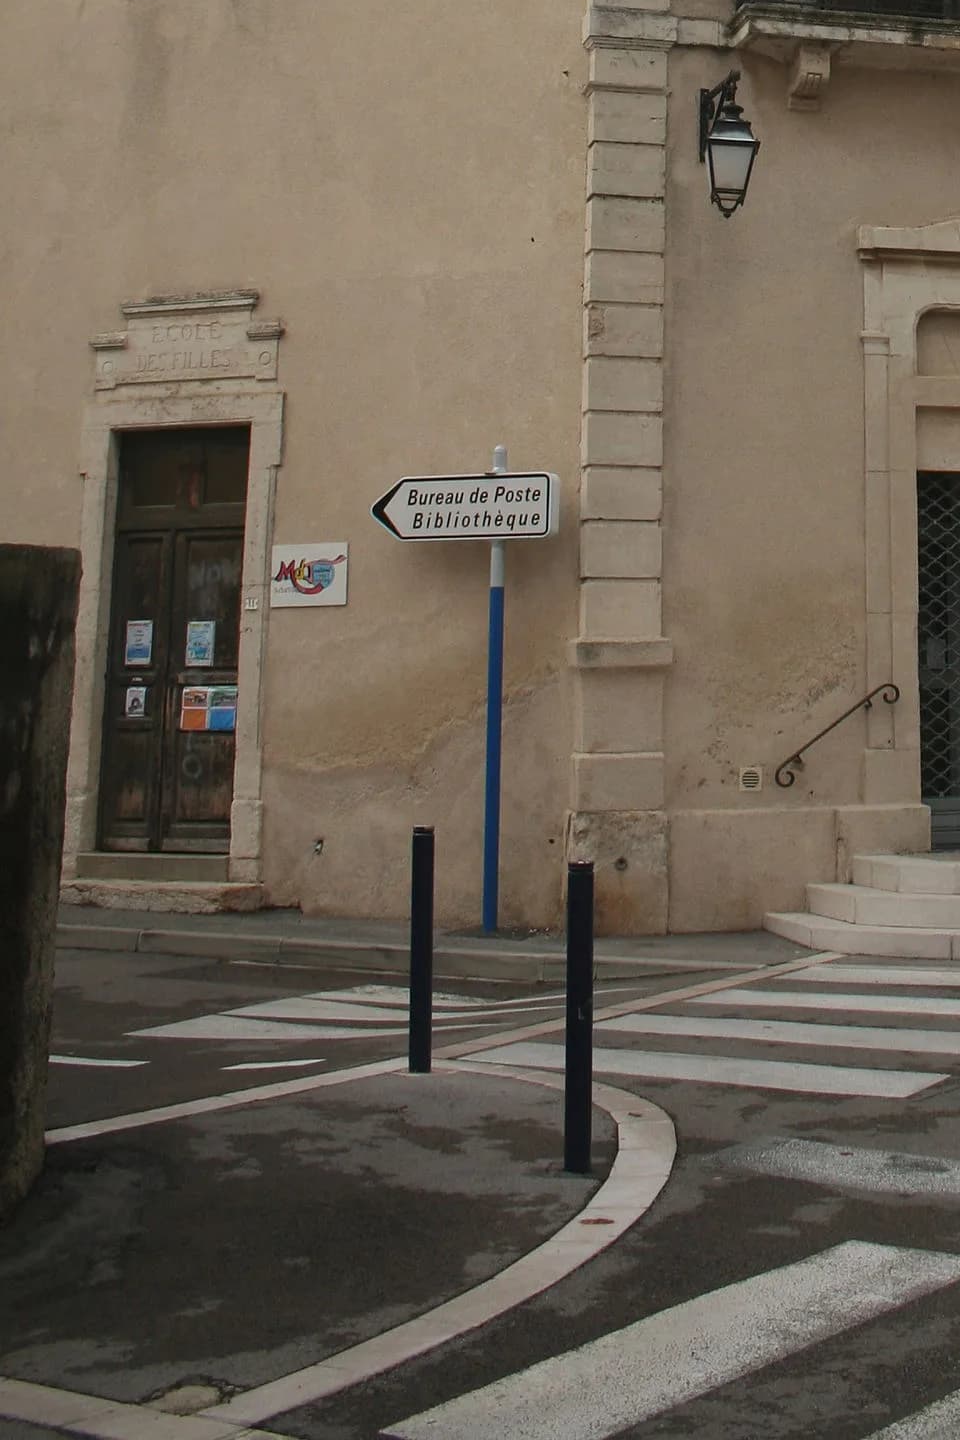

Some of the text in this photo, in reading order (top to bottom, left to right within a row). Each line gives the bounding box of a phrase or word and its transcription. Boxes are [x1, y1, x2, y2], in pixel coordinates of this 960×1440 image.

[151, 320, 224, 344] ECOLE
[136, 347, 231, 374] DES FILLES
[407, 485, 541, 506] Bureau de Poste
[412, 510, 541, 531] Bibliothèque
